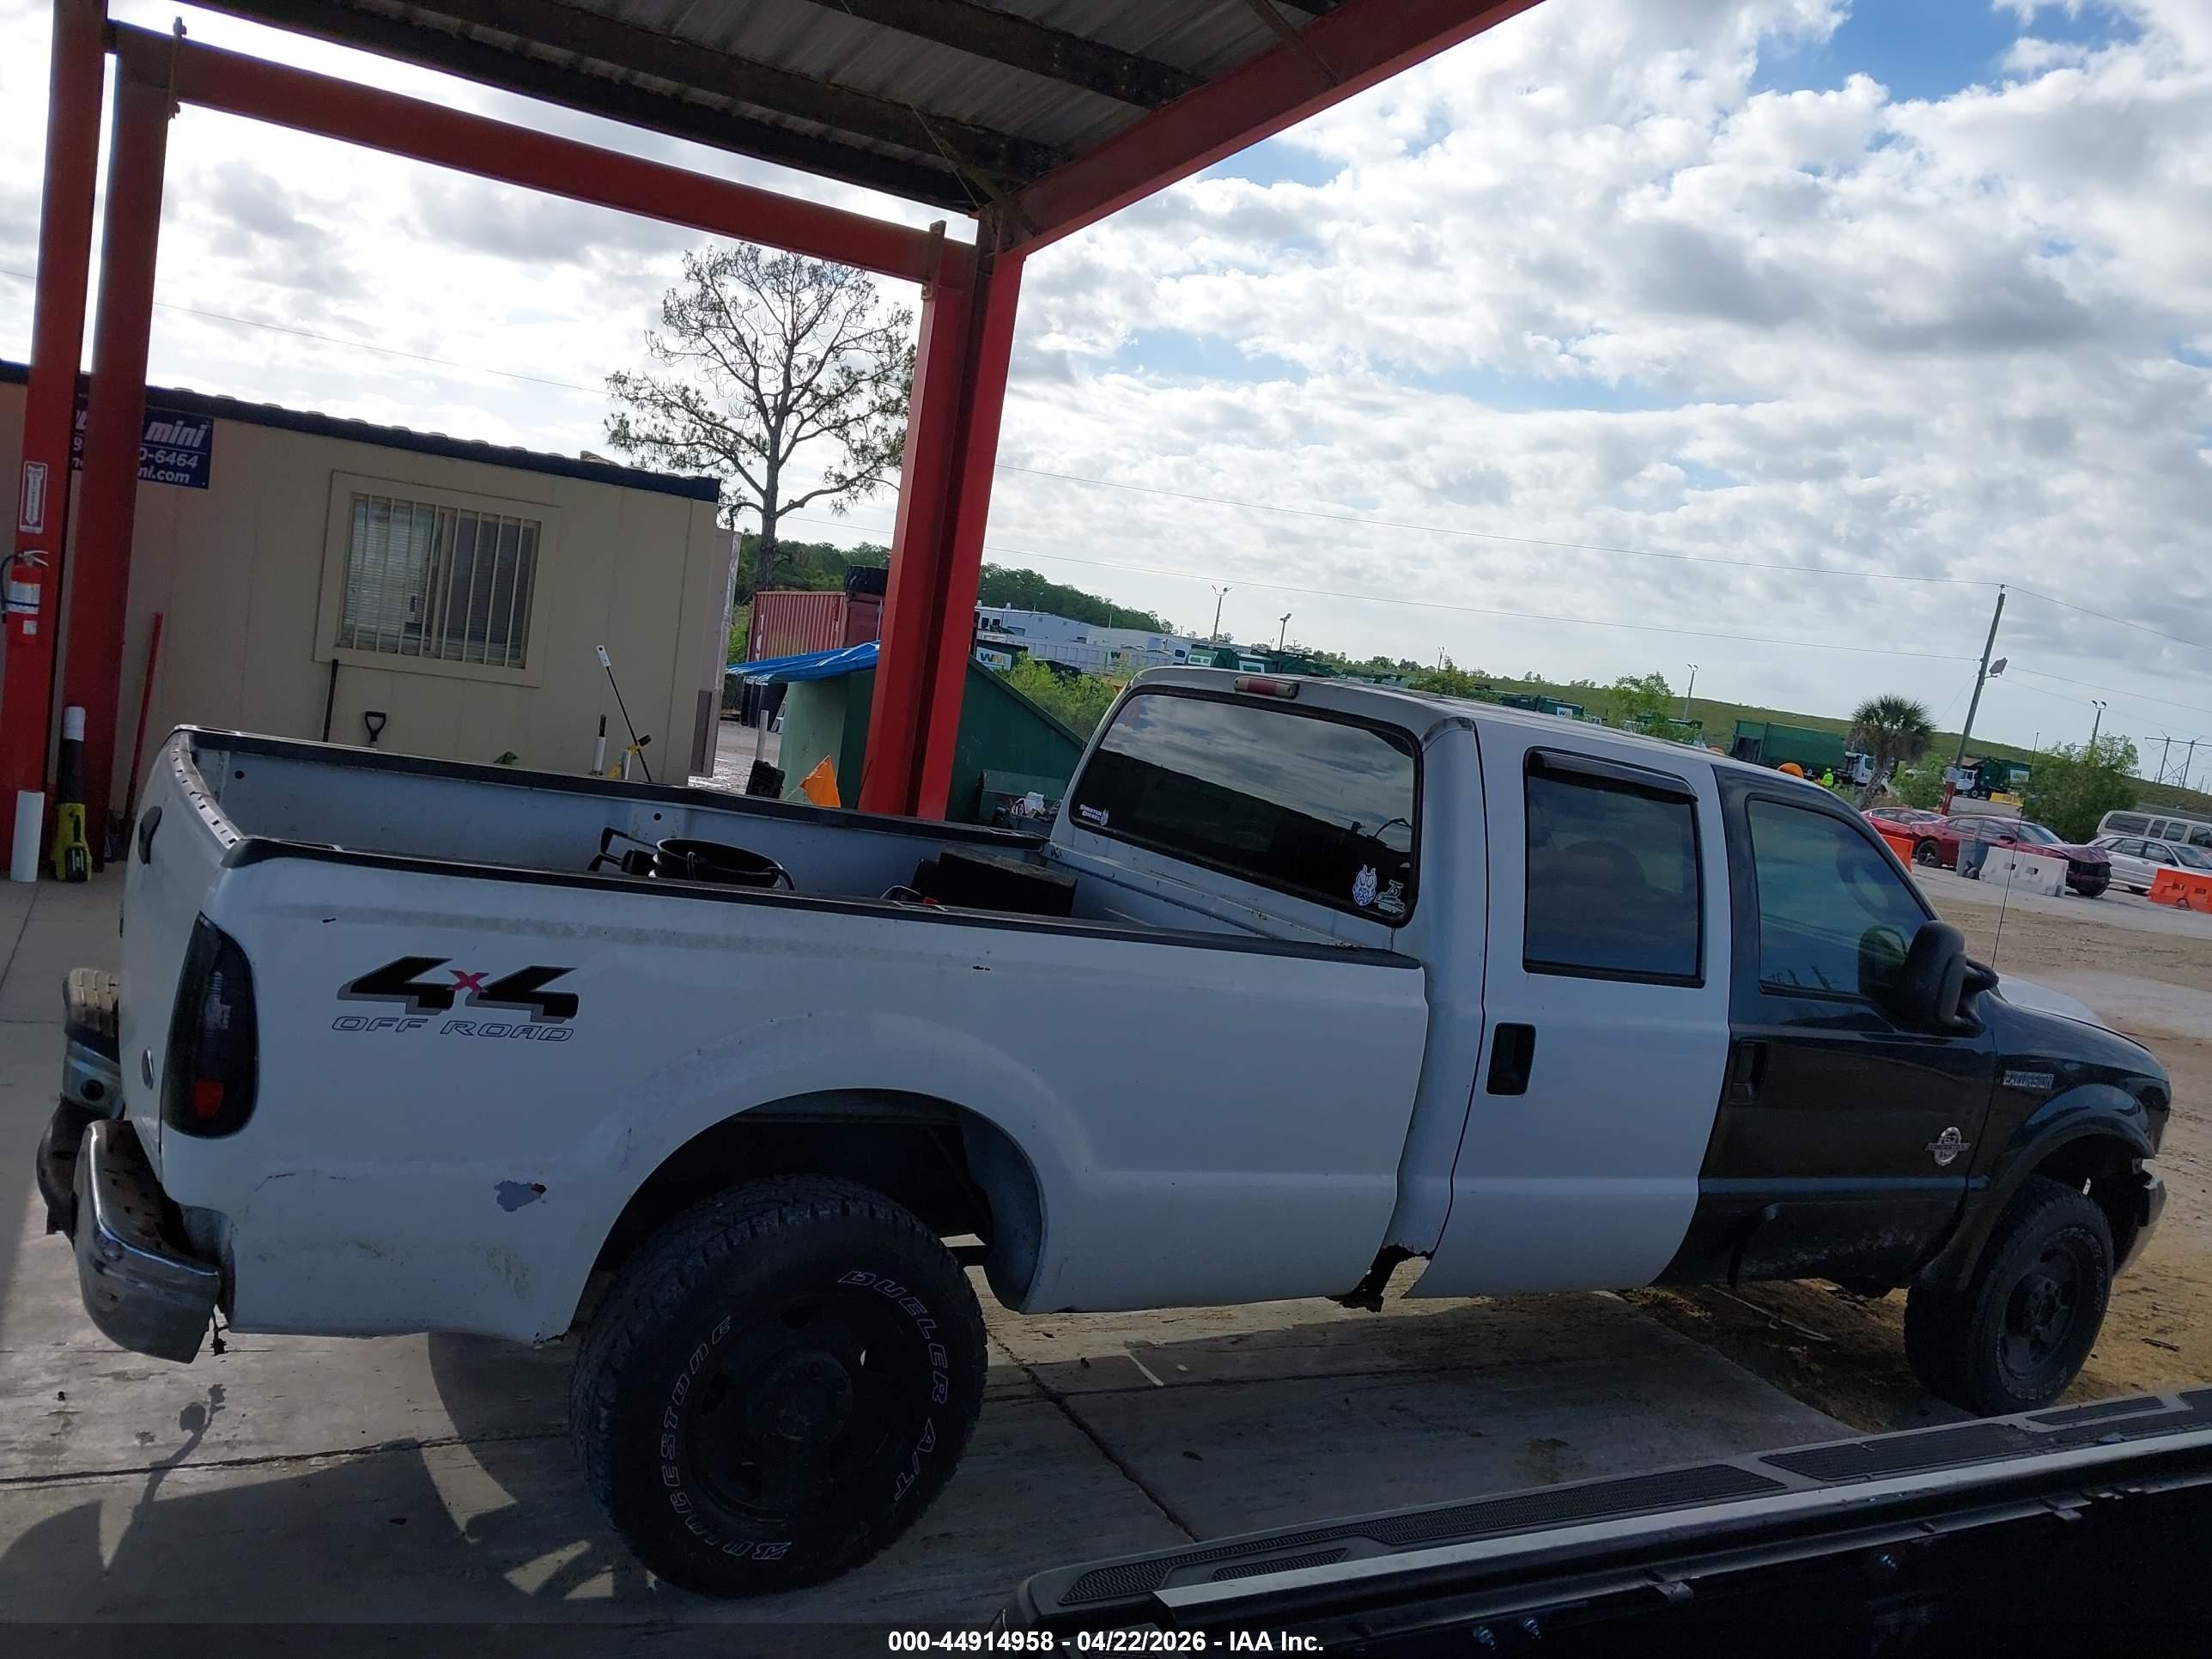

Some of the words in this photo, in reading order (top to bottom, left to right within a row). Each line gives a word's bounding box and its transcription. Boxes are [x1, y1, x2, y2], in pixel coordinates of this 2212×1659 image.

[144, 420, 208, 447] mini
[139, 447, 198, 469] 0-6464
[980, 652, 1006, 664] WM
[331, 1015, 428, 1033] OFF
[440, 1019, 574, 1042] ROAD
[837, 1270, 950, 1406] DUELER
